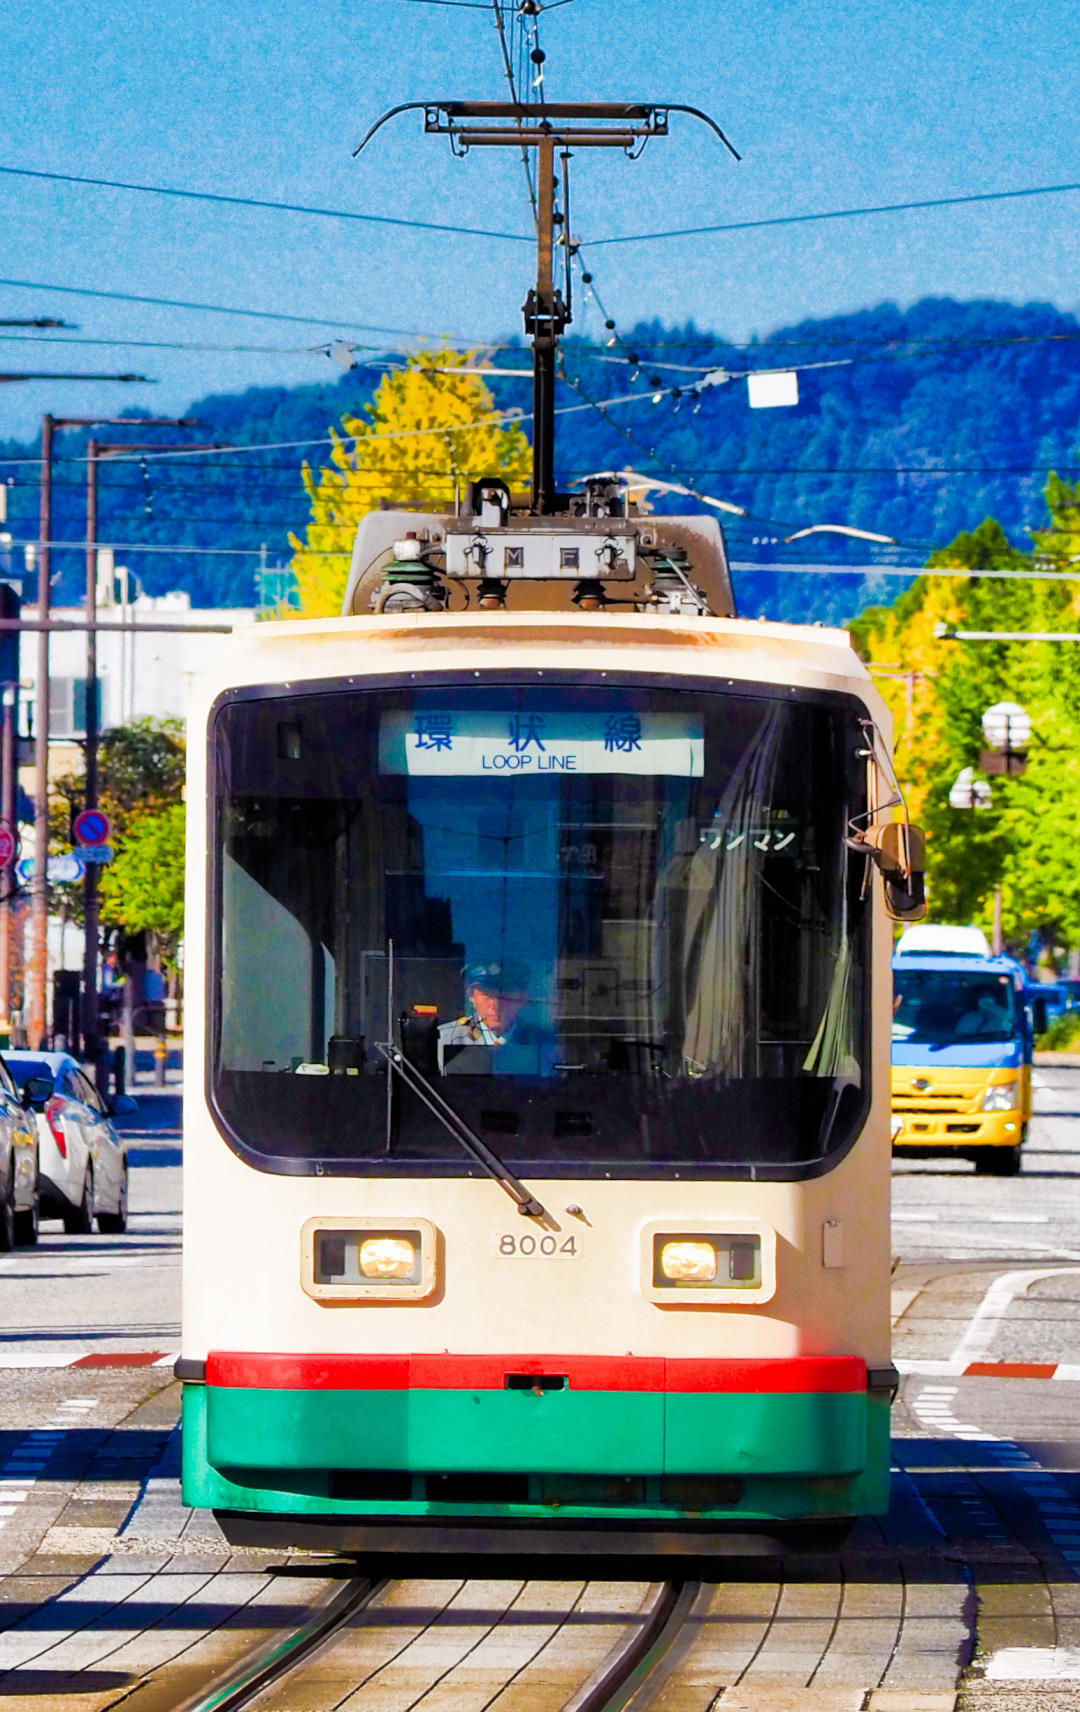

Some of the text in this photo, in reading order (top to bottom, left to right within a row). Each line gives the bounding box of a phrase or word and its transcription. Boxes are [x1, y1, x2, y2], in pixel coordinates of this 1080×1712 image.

[506, 548, 577, 567] M F
[414, 713, 643, 752] 環状線
[482, 754, 577, 770] LOOP LINE
[700, 828, 796, 851] ワンマン
[499, 1234, 578, 1256] 8004
